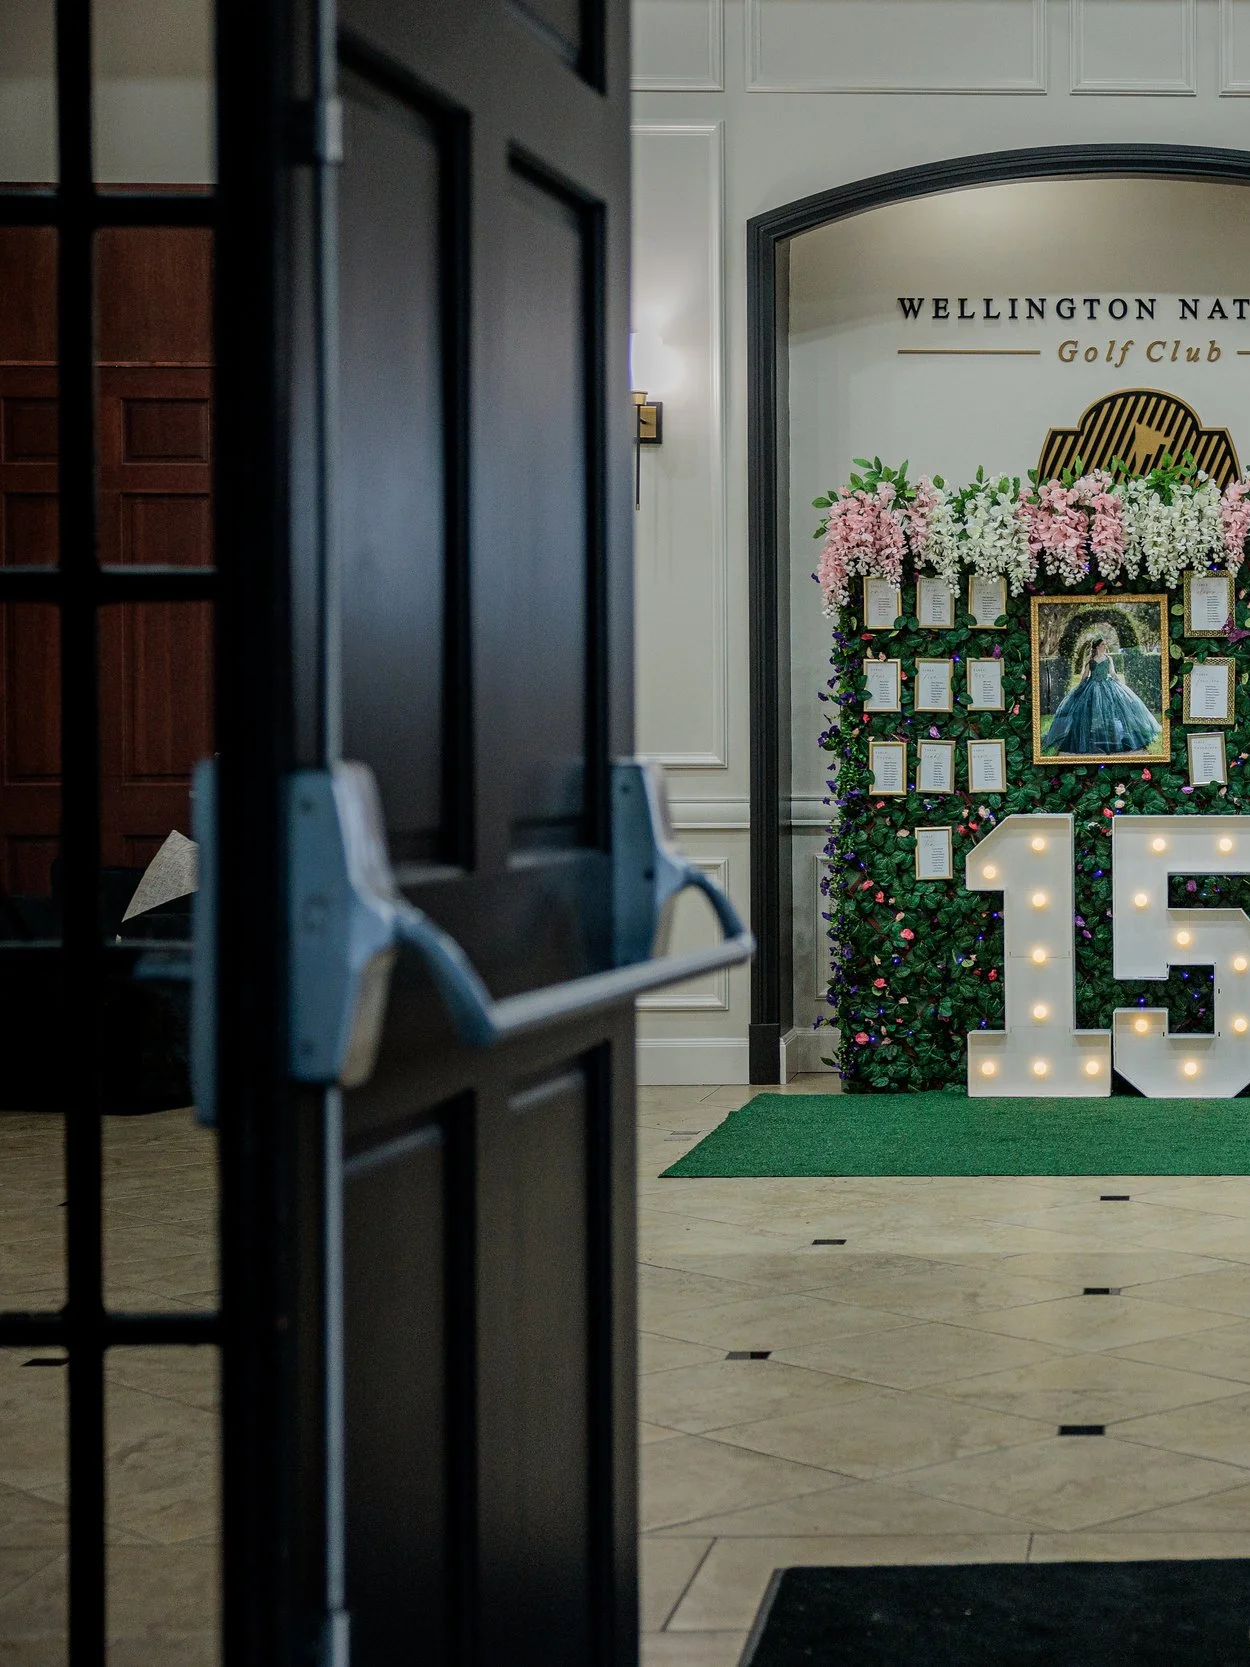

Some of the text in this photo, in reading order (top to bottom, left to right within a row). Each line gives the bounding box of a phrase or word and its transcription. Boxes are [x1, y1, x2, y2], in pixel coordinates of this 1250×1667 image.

[897, 298, 1156, 319] WELLINGTON
[1058, 340, 1222, 368] Golf Club
